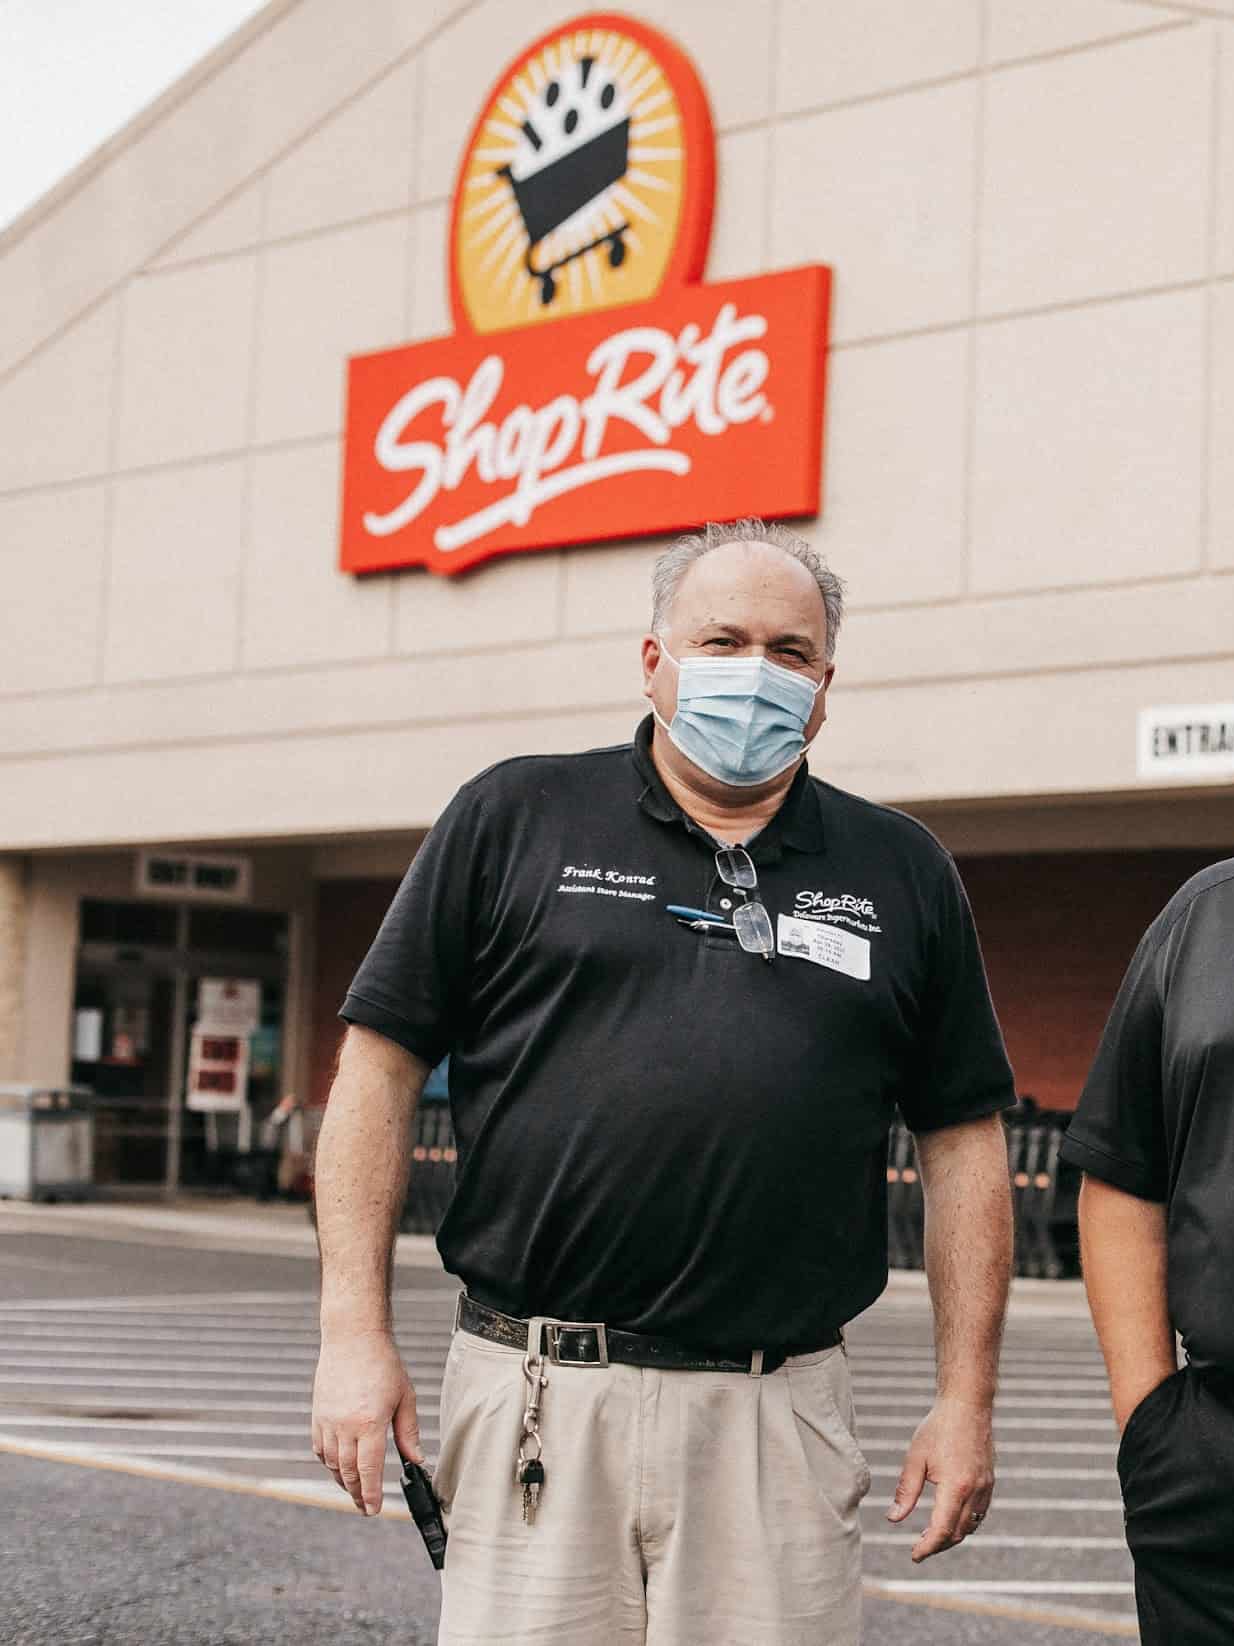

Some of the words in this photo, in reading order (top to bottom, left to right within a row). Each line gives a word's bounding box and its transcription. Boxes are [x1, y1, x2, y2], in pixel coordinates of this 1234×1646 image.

[363, 303, 772, 551] ShopRite
[562, 866, 602, 880] Frank
[605, 870, 656, 885] Konrad
[795, 891, 874, 917] ShopRite
